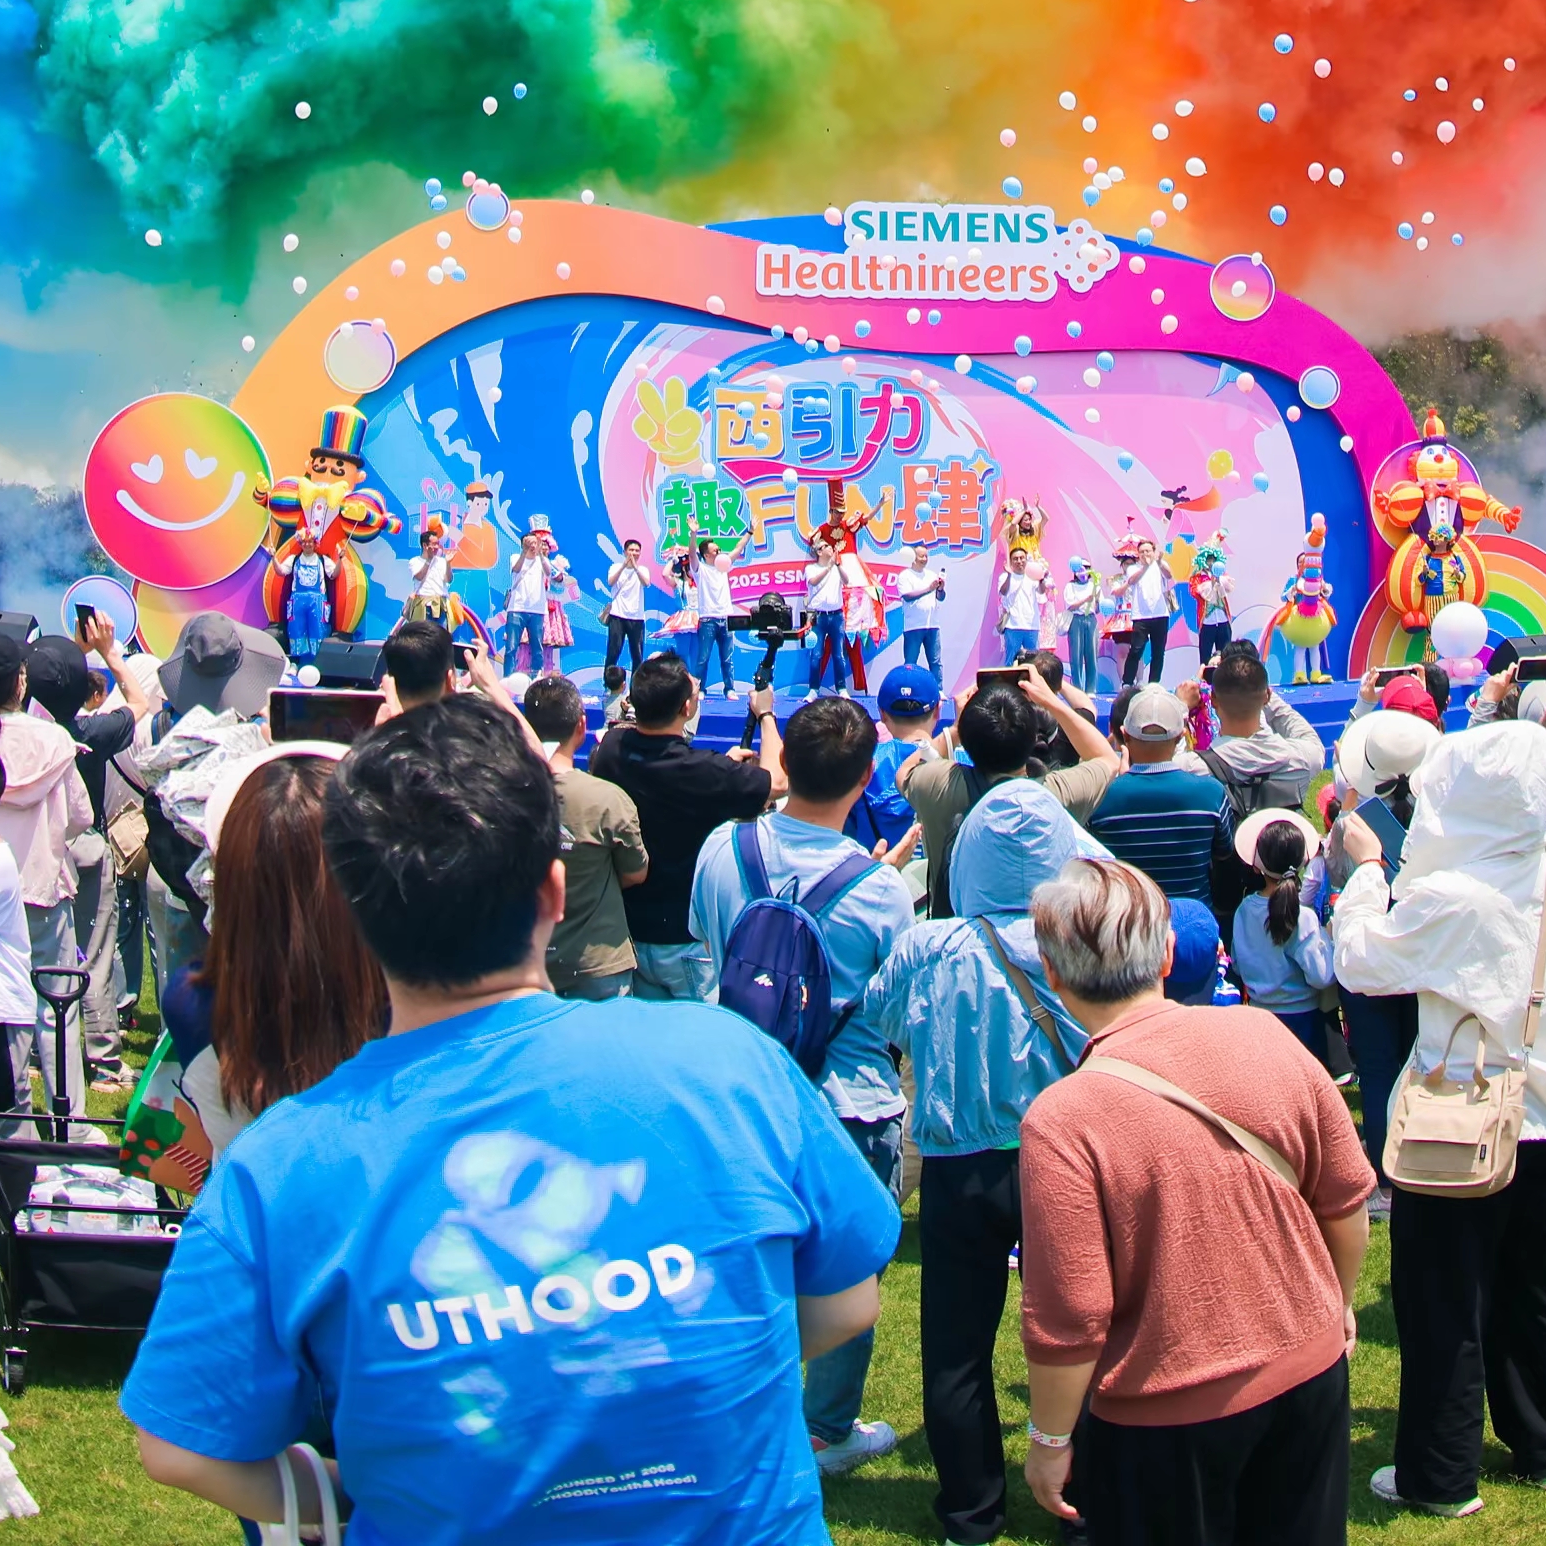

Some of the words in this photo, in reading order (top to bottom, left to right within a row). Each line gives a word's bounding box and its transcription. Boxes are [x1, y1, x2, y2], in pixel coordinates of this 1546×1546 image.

[851, 210, 1049, 243] SIEMENS
[715, 383, 923, 484] 西引力
[729, 571, 771, 589] 2025
[774, 570, 807, 585] SSM
[387, 1243, 695, 1350] UTHOOD
[619, 1471, 636, 1482] IN
